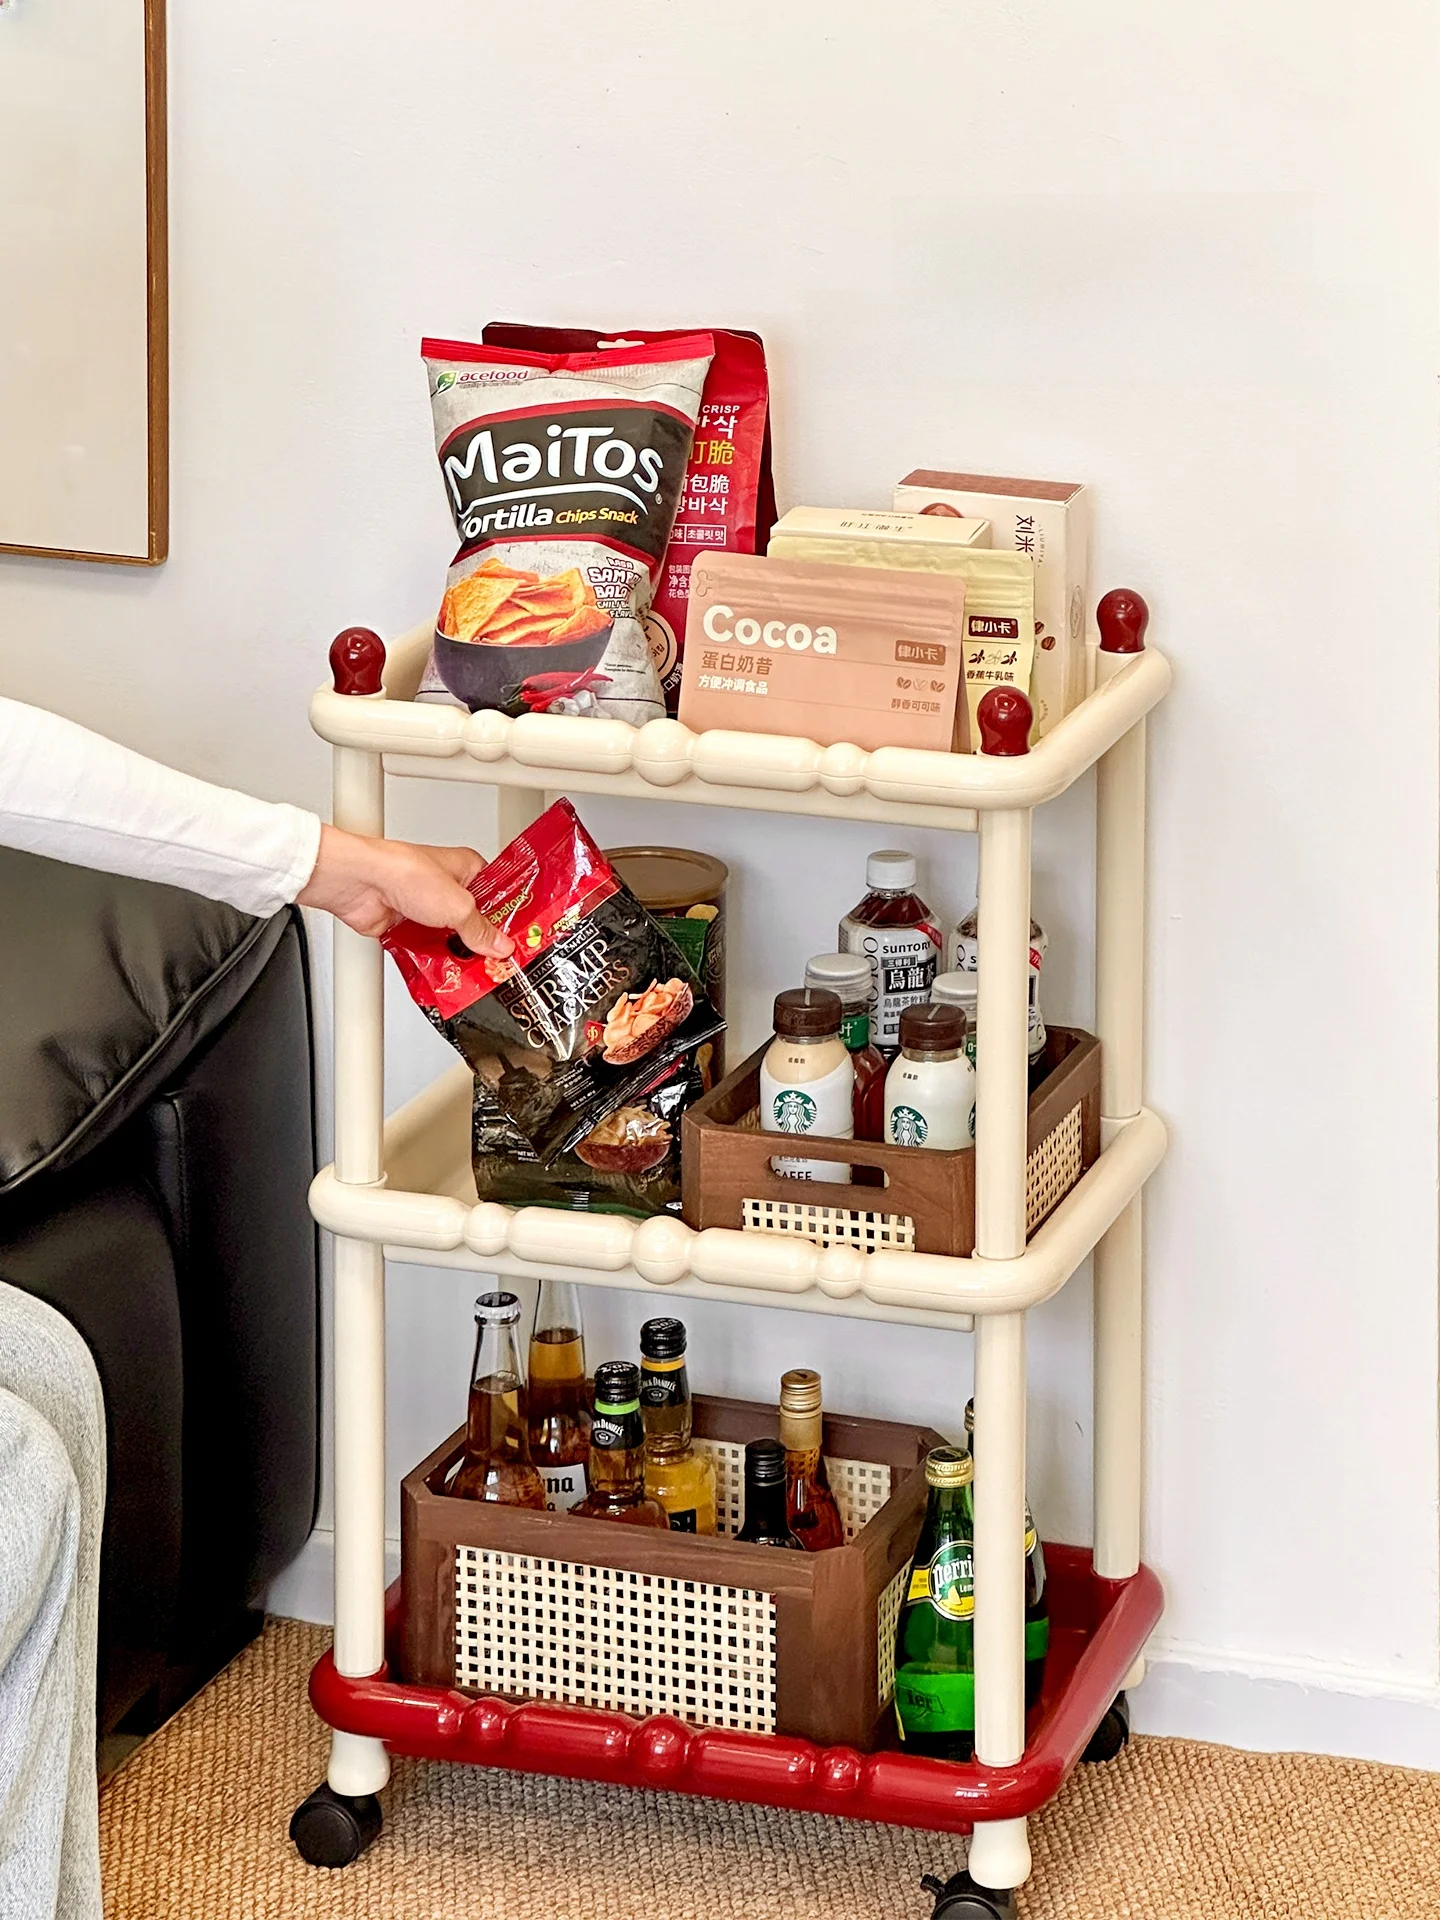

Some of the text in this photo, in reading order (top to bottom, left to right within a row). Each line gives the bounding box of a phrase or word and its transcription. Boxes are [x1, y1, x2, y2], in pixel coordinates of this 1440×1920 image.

[460, 370, 529, 382] acefood
[702, 404, 740, 414] CRISP
[444, 424, 664, 511] MaiTos
[461, 502, 639, 539] ortilla Chips Snack
[1015, 515, 1035, 561] 刘米
[702, 604, 837, 655] Cocoa
[701, 650, 773, 676] 蛋白奶昔
[697, 674, 769, 695] 方便冲调食品
[966, 669, 1014, 682] 香蕉牛乳味
[960, 1584, 974, 1593] Lem
